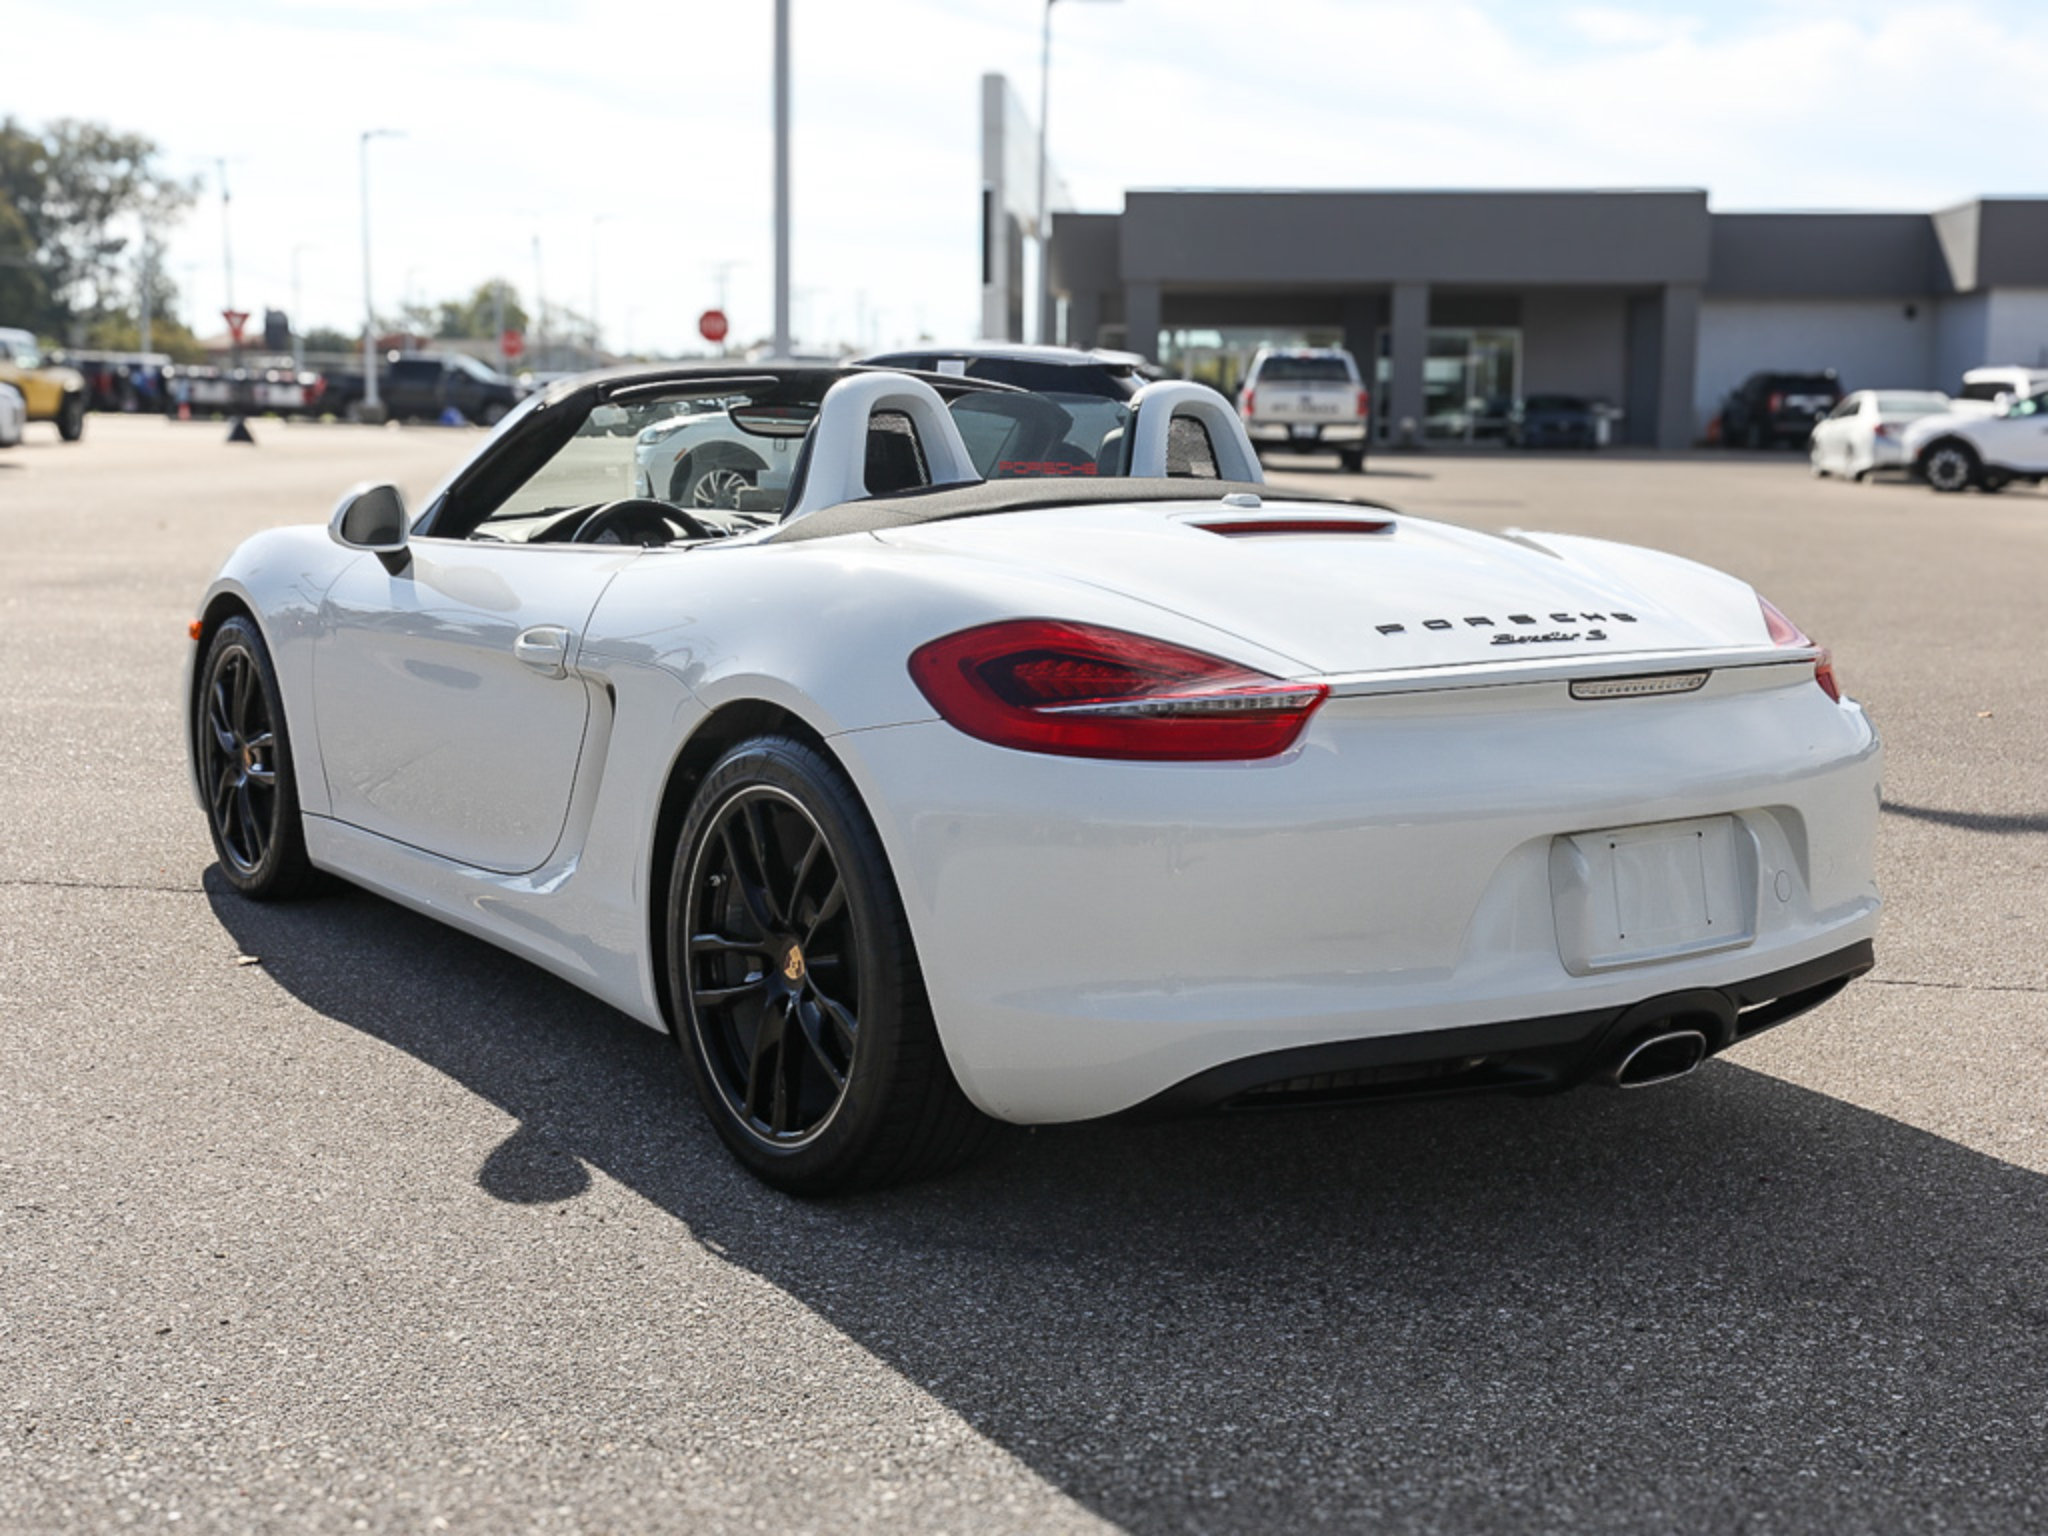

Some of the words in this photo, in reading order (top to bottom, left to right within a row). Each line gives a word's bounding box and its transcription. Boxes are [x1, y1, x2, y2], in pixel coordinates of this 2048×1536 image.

[998, 460, 1099, 475] PORSCHE
[1375, 612, 1638, 635] PORSCHE
[1490, 631, 1581, 645] Boxster
[1585, 629, 1607, 641] S
